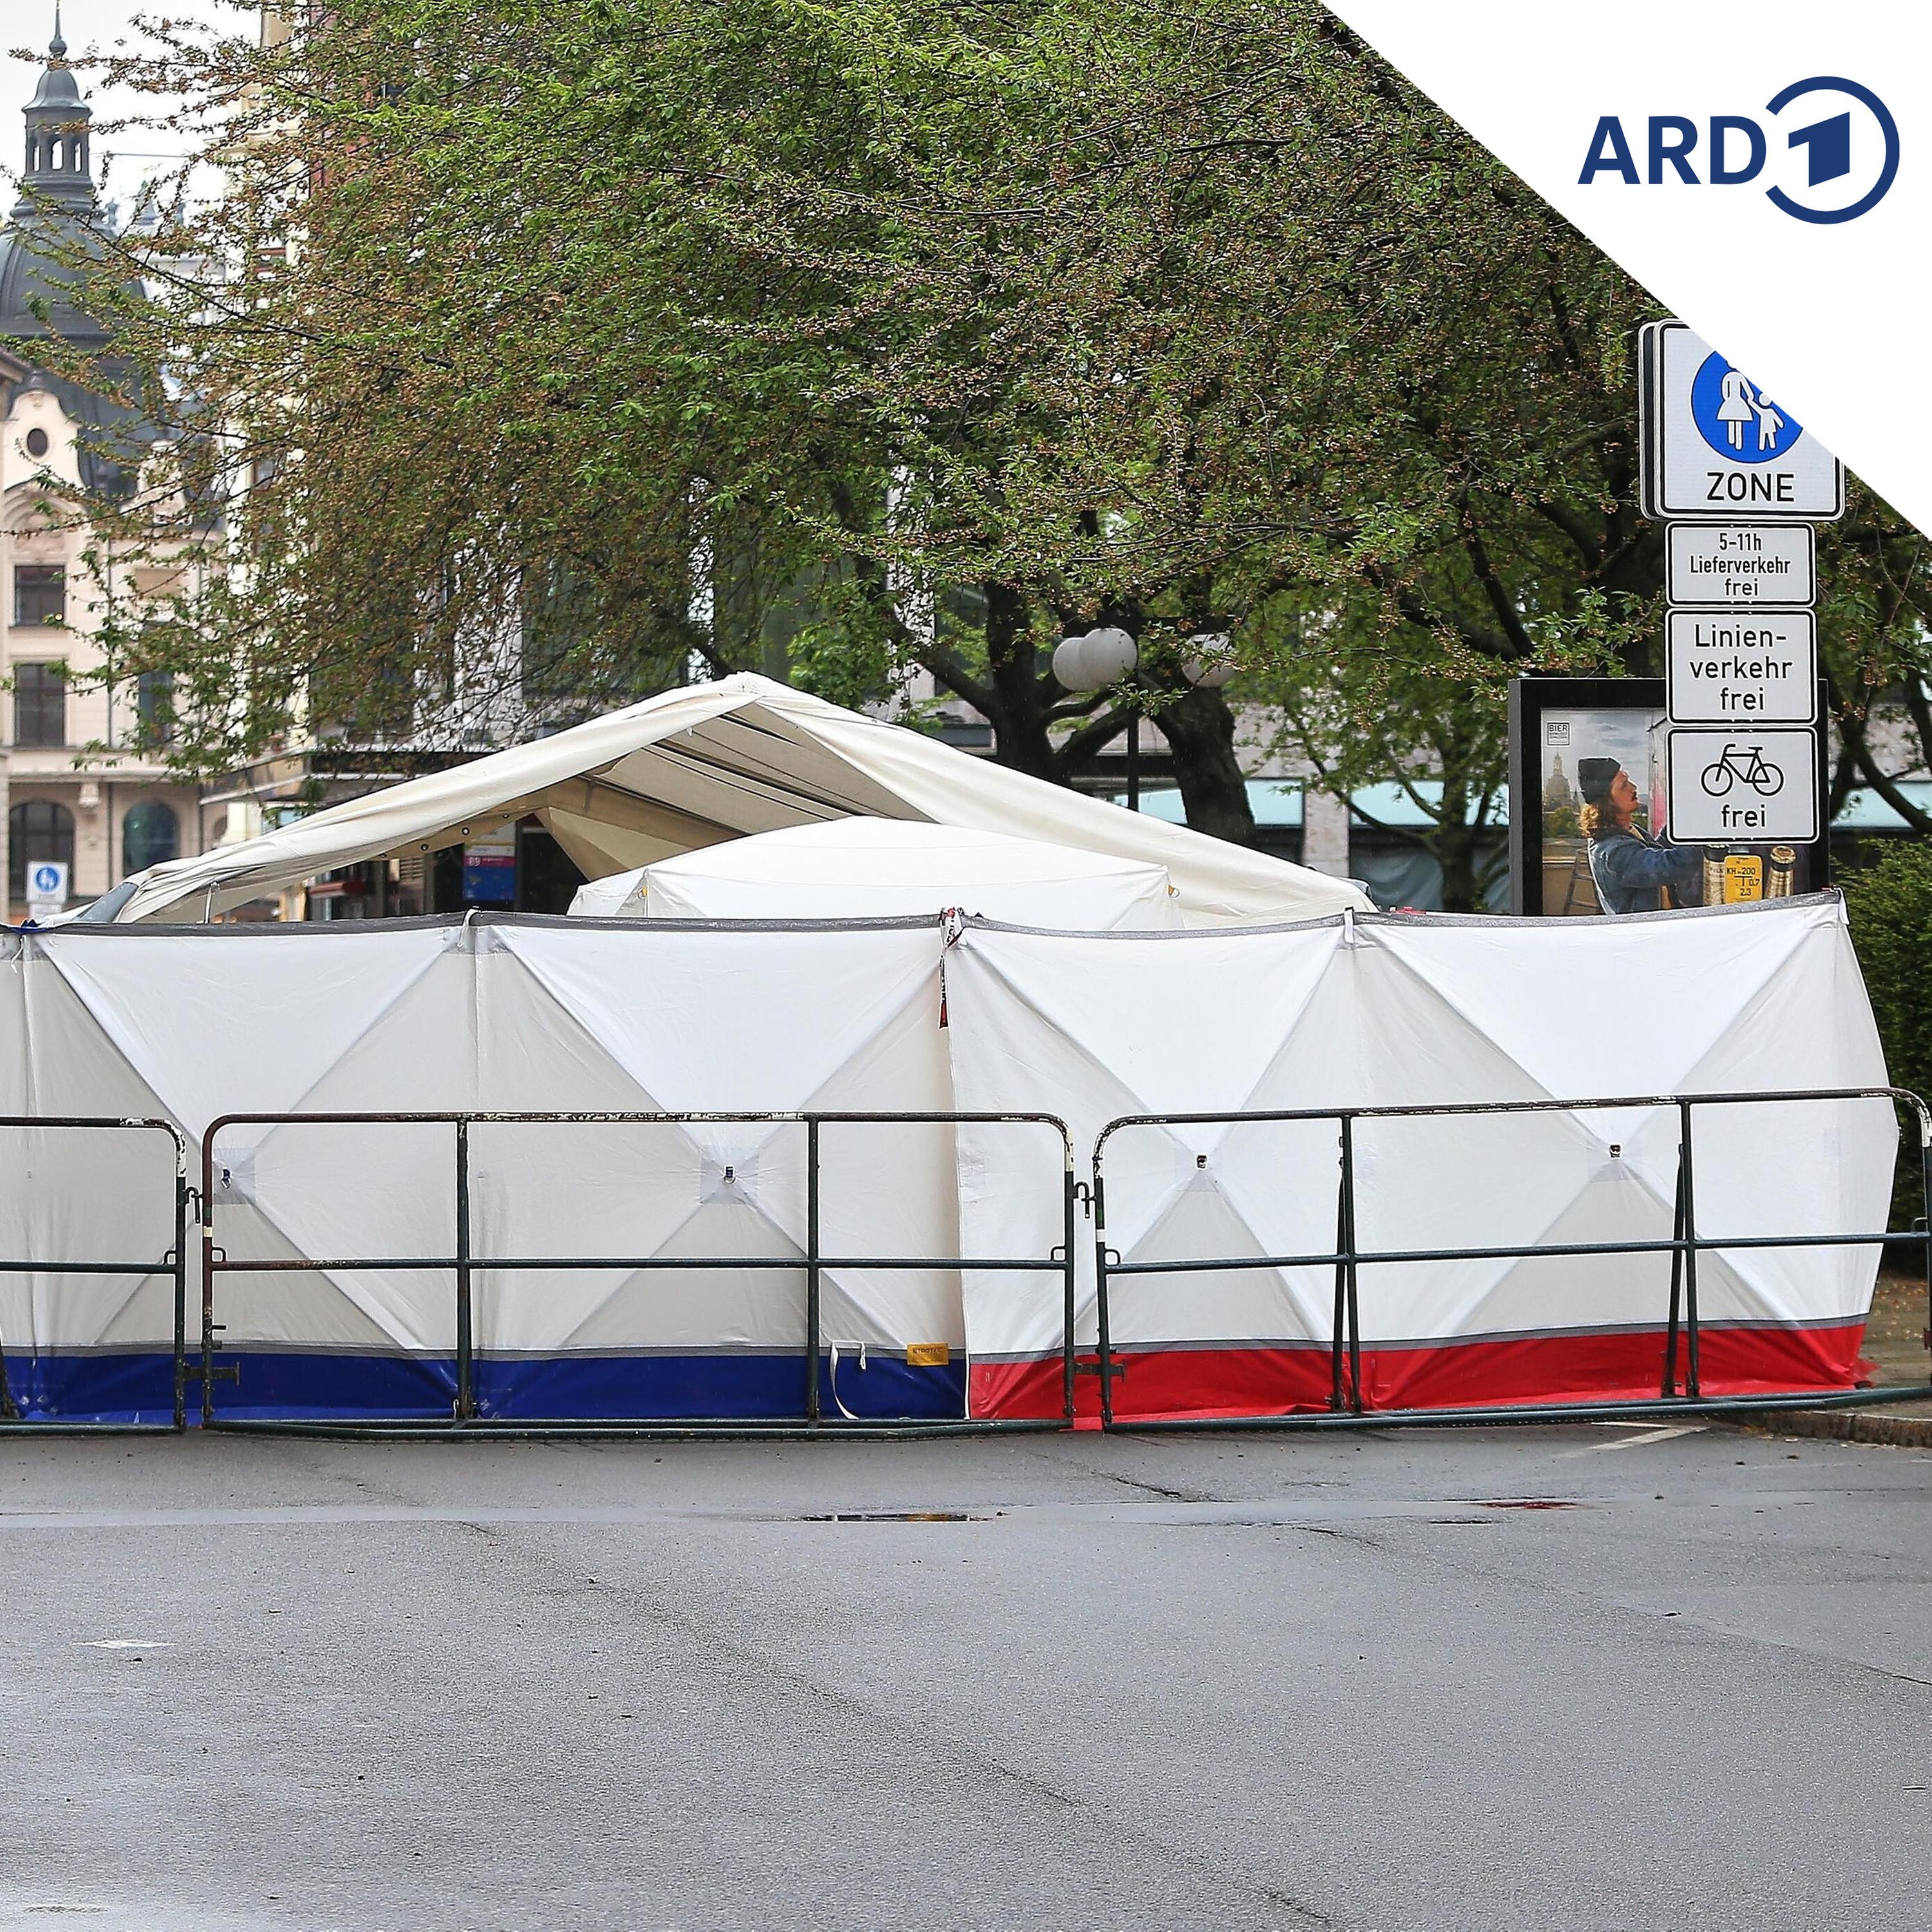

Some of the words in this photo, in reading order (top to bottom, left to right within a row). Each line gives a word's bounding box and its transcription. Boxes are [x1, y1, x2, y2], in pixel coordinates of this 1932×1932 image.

[1707, 472, 1795, 502] ZONE
[1719, 533, 1761, 551] 5-11h
[1690, 555, 1791, 574] Lieferverkehr
[1725, 578, 1757, 596] frei
[1695, 624, 1786, 647] Linien-
[1689, 656, 1793, 679] verkehr
[1720, 687, 1765, 710] frei
[1721, 804, 1766, 828] frei
